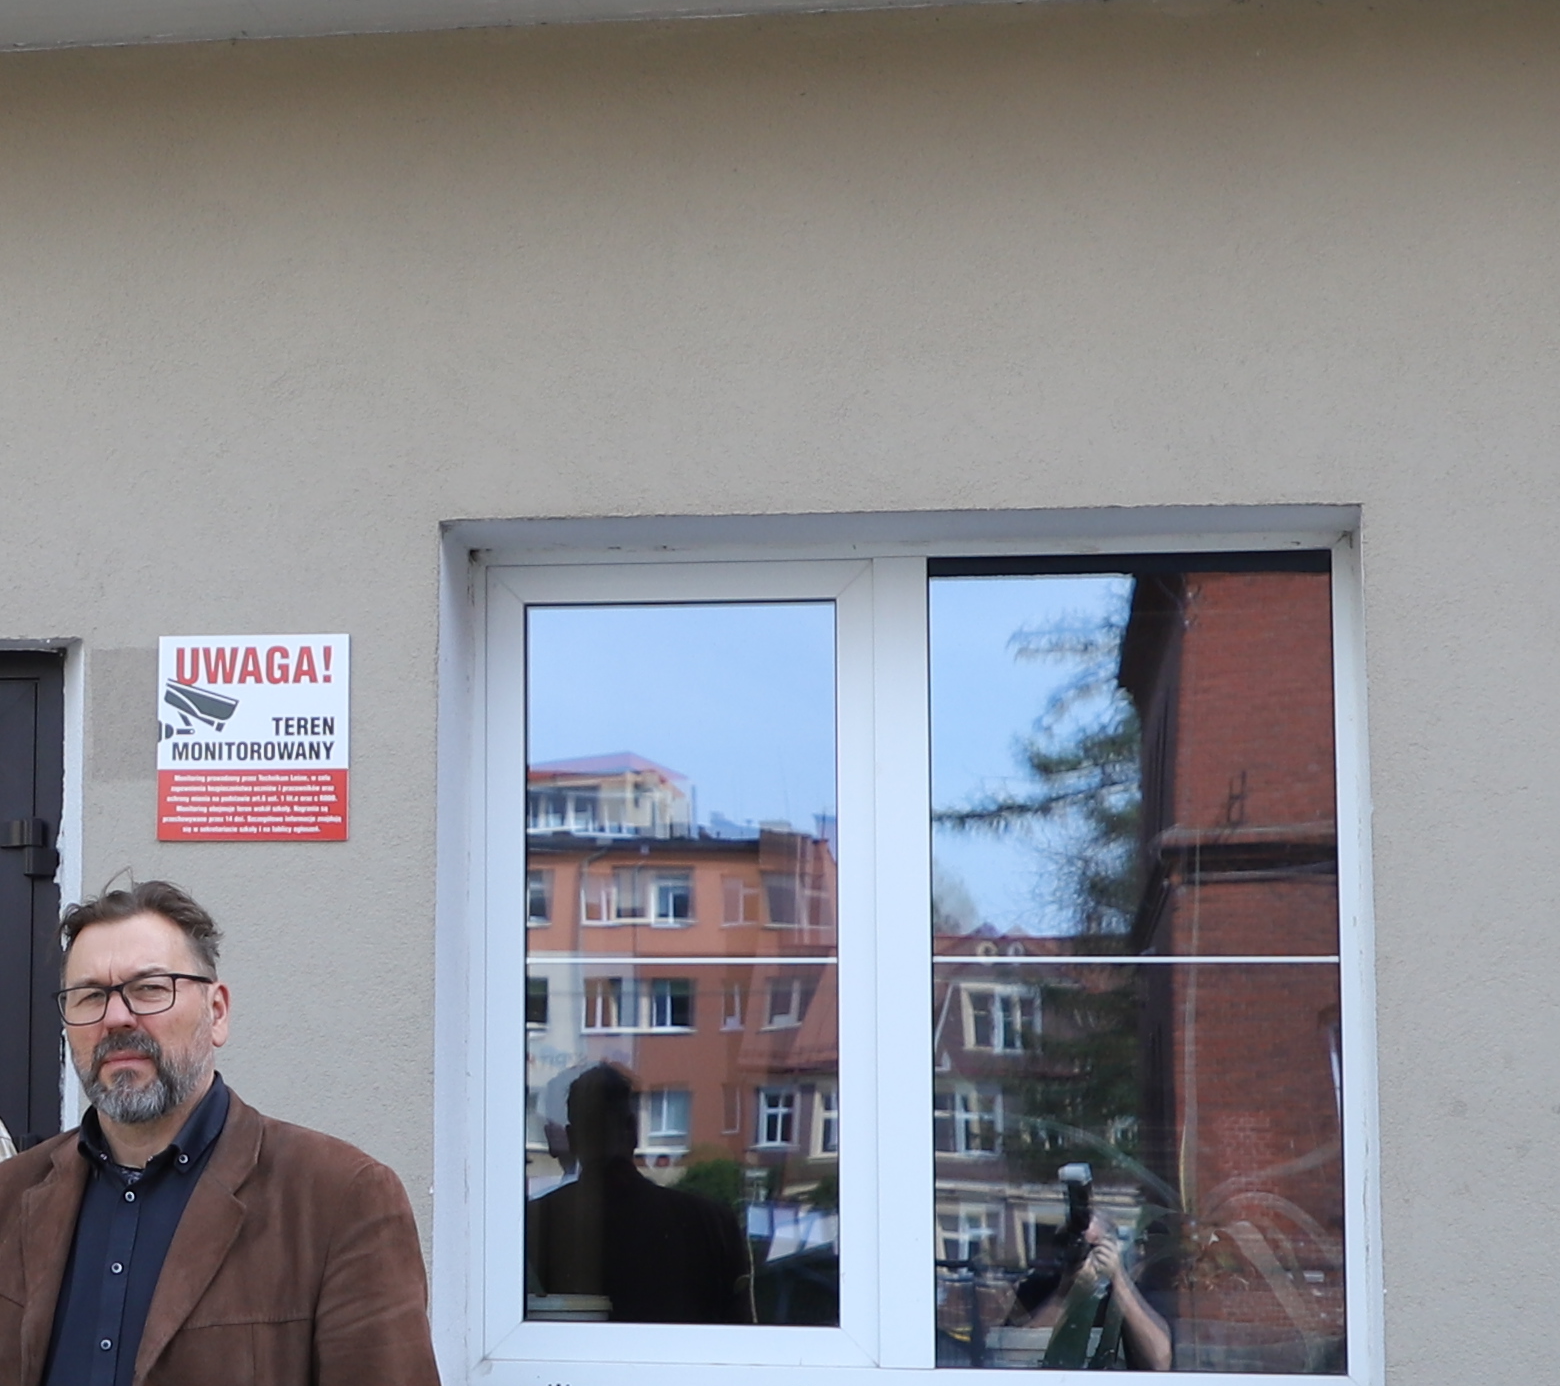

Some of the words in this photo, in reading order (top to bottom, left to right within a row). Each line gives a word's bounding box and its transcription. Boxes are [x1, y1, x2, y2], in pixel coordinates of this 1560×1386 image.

[176, 646, 333, 685] UWAGA!
[272, 717, 335, 736] TEREN
[172, 741, 335, 761] MONITOROWANY
